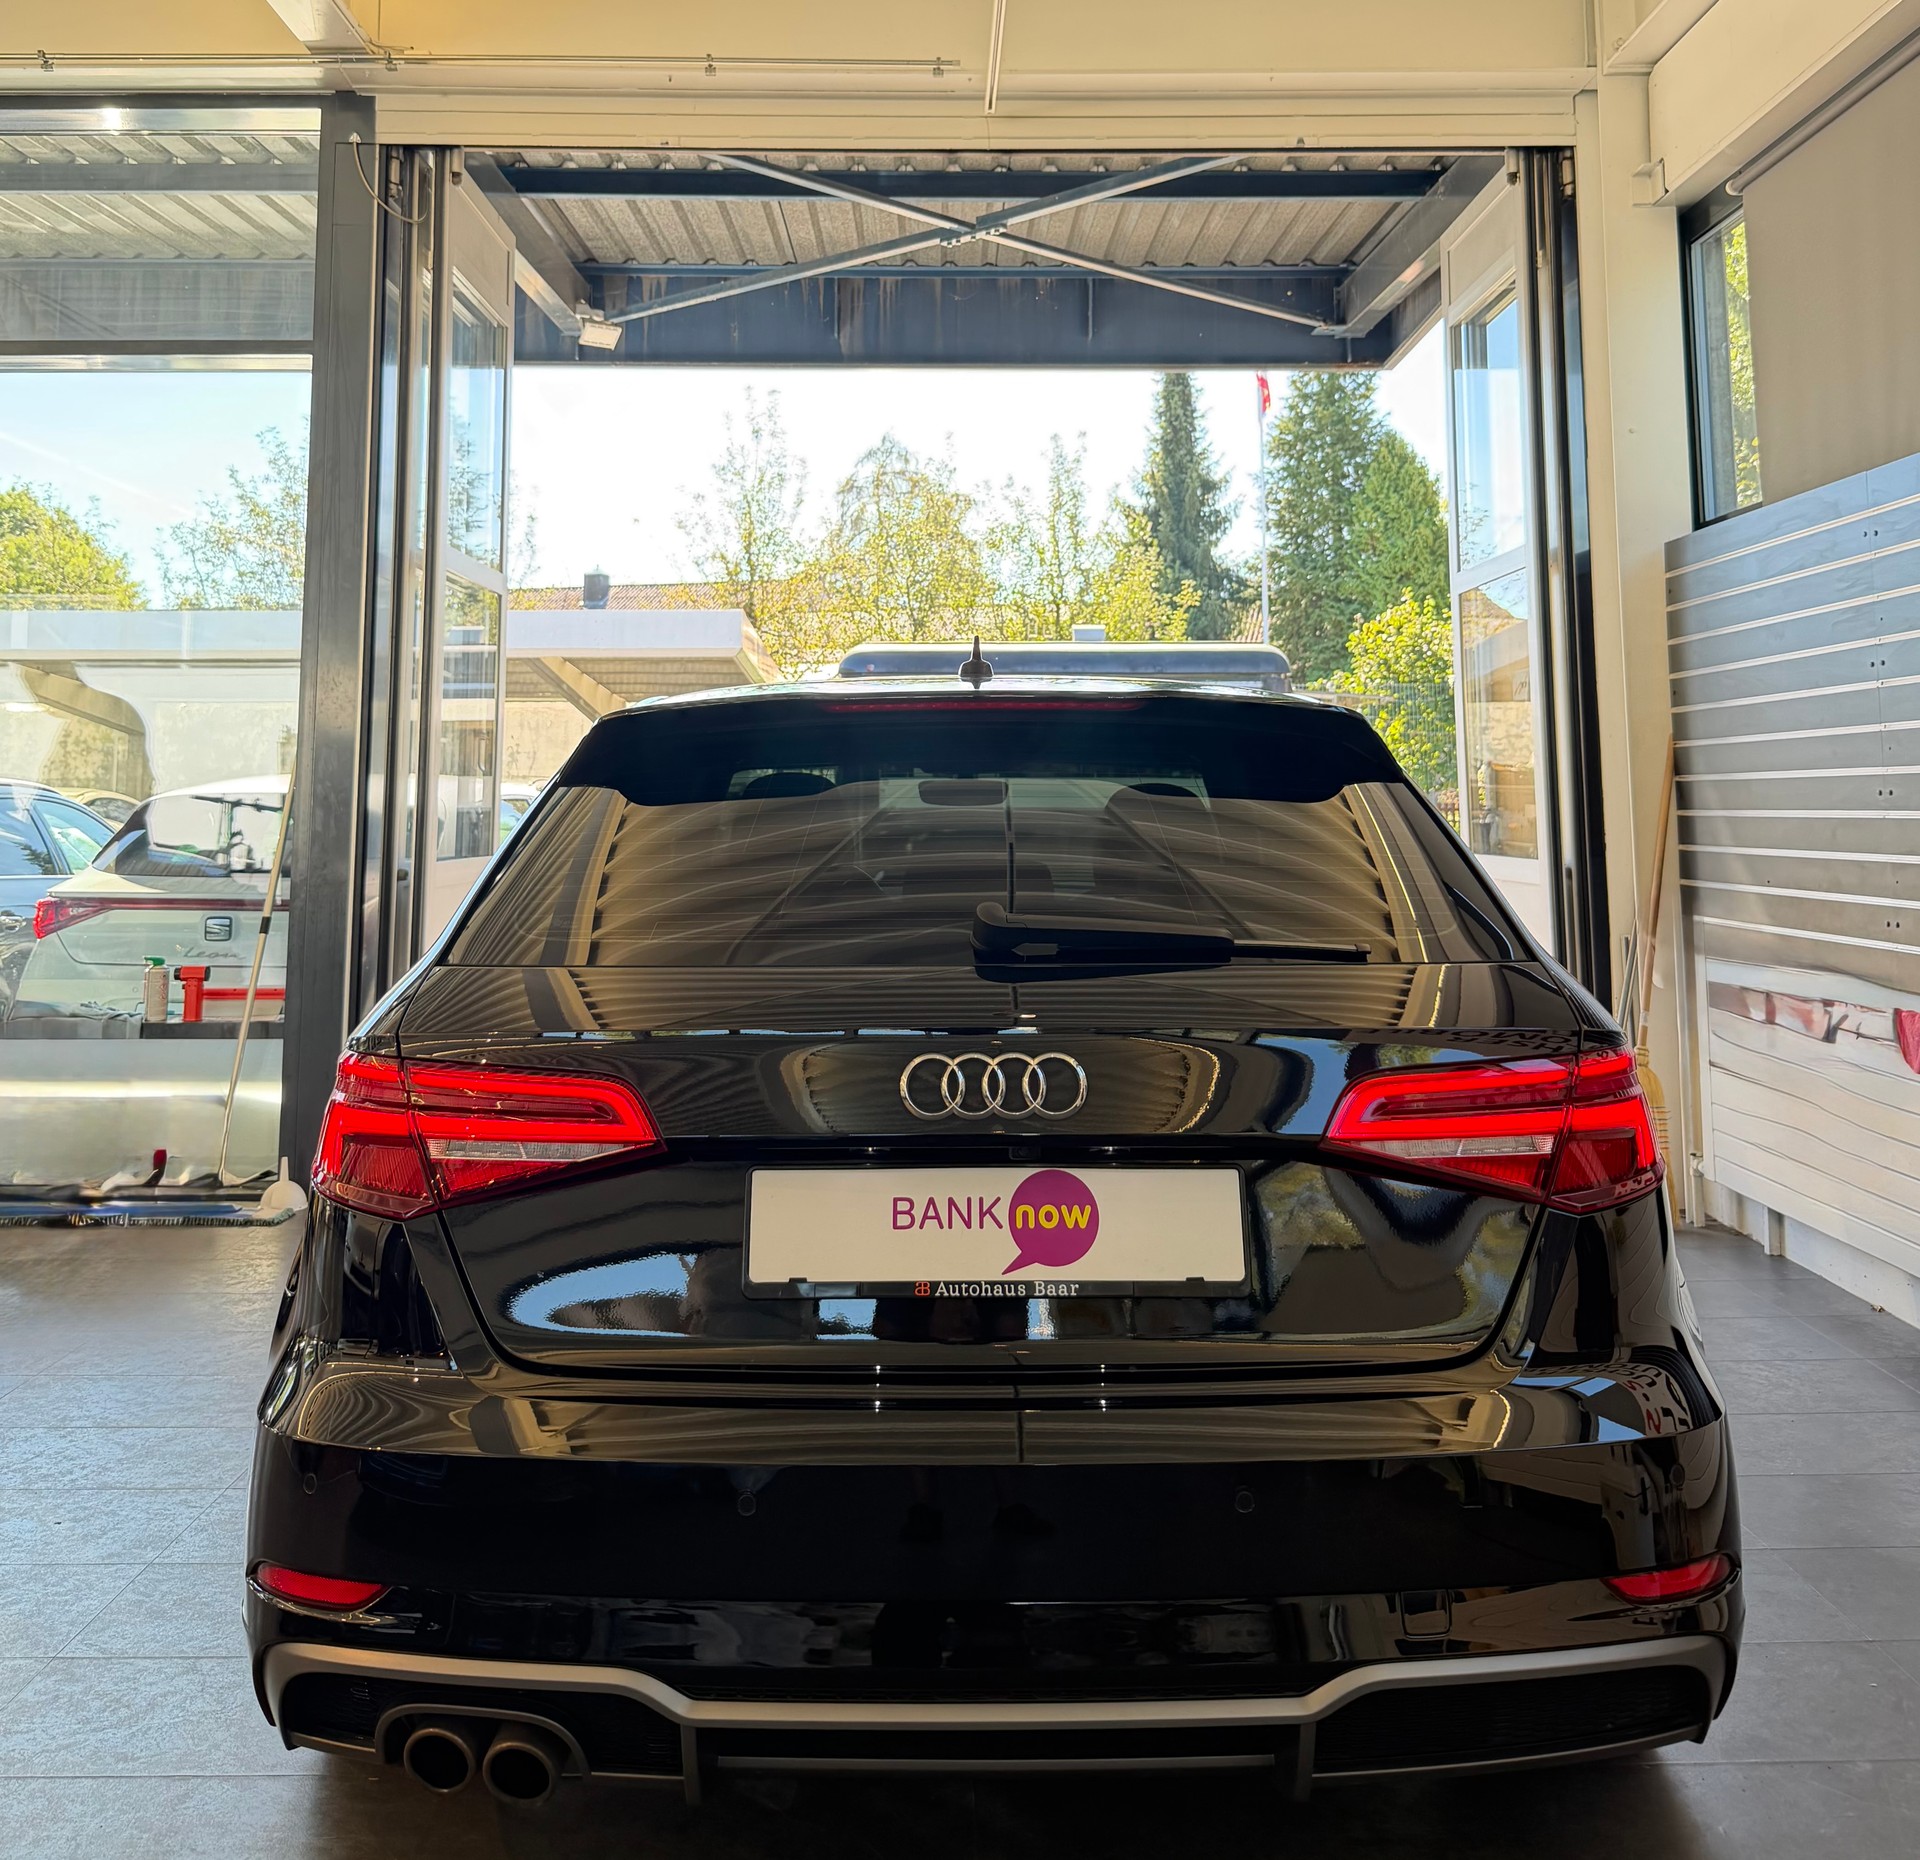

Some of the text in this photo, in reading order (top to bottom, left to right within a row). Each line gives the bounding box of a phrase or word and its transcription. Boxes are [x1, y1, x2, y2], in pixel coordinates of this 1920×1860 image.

[892, 1196, 1092, 1230] BANK now
[934, 1281, 1026, 1297] Autohaus
[1033, 1281, 1080, 1297] Baar
